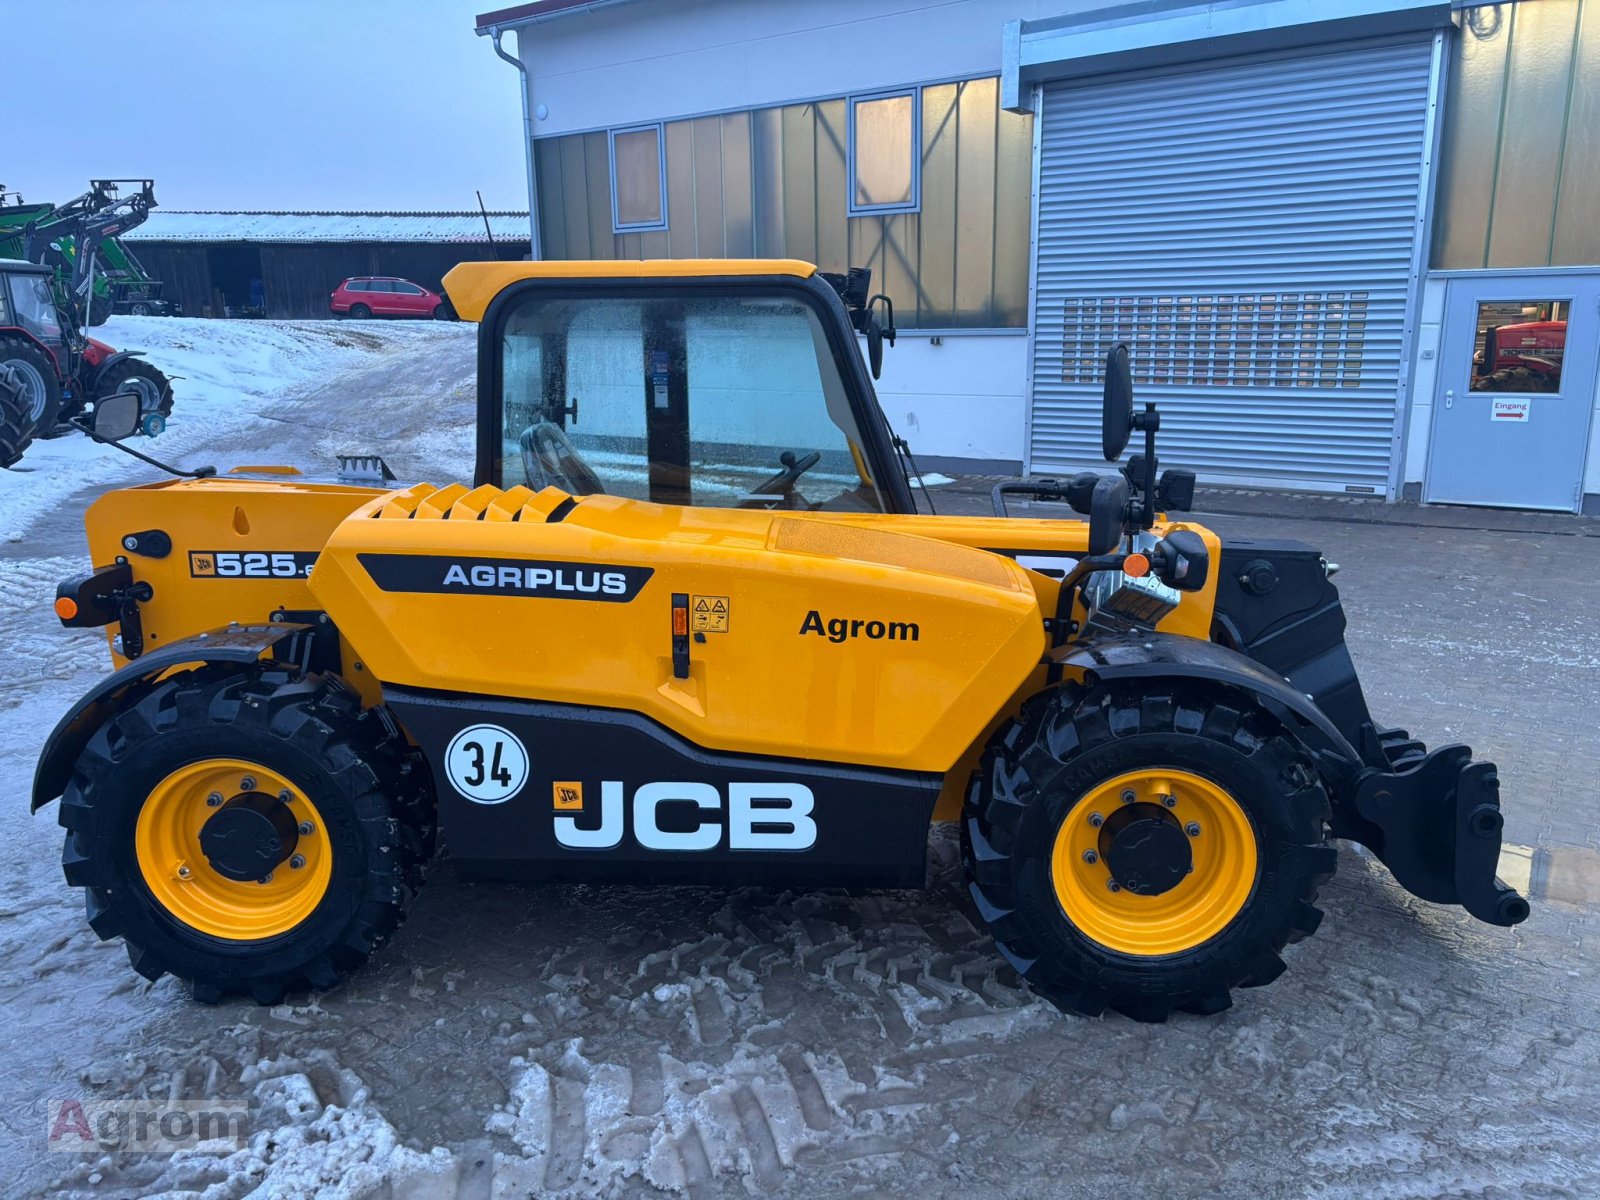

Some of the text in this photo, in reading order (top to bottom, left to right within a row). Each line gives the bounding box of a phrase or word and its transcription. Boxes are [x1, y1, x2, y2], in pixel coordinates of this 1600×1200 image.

[1495, 402, 1527, 411] Eingang
[442, 564, 627, 596] AGRIPLUS
[799, 610, 921, 643] Agrom
[462, 742, 512, 788] 34
[560, 787, 578, 803] JCB
[553, 781, 818, 851] JCB
